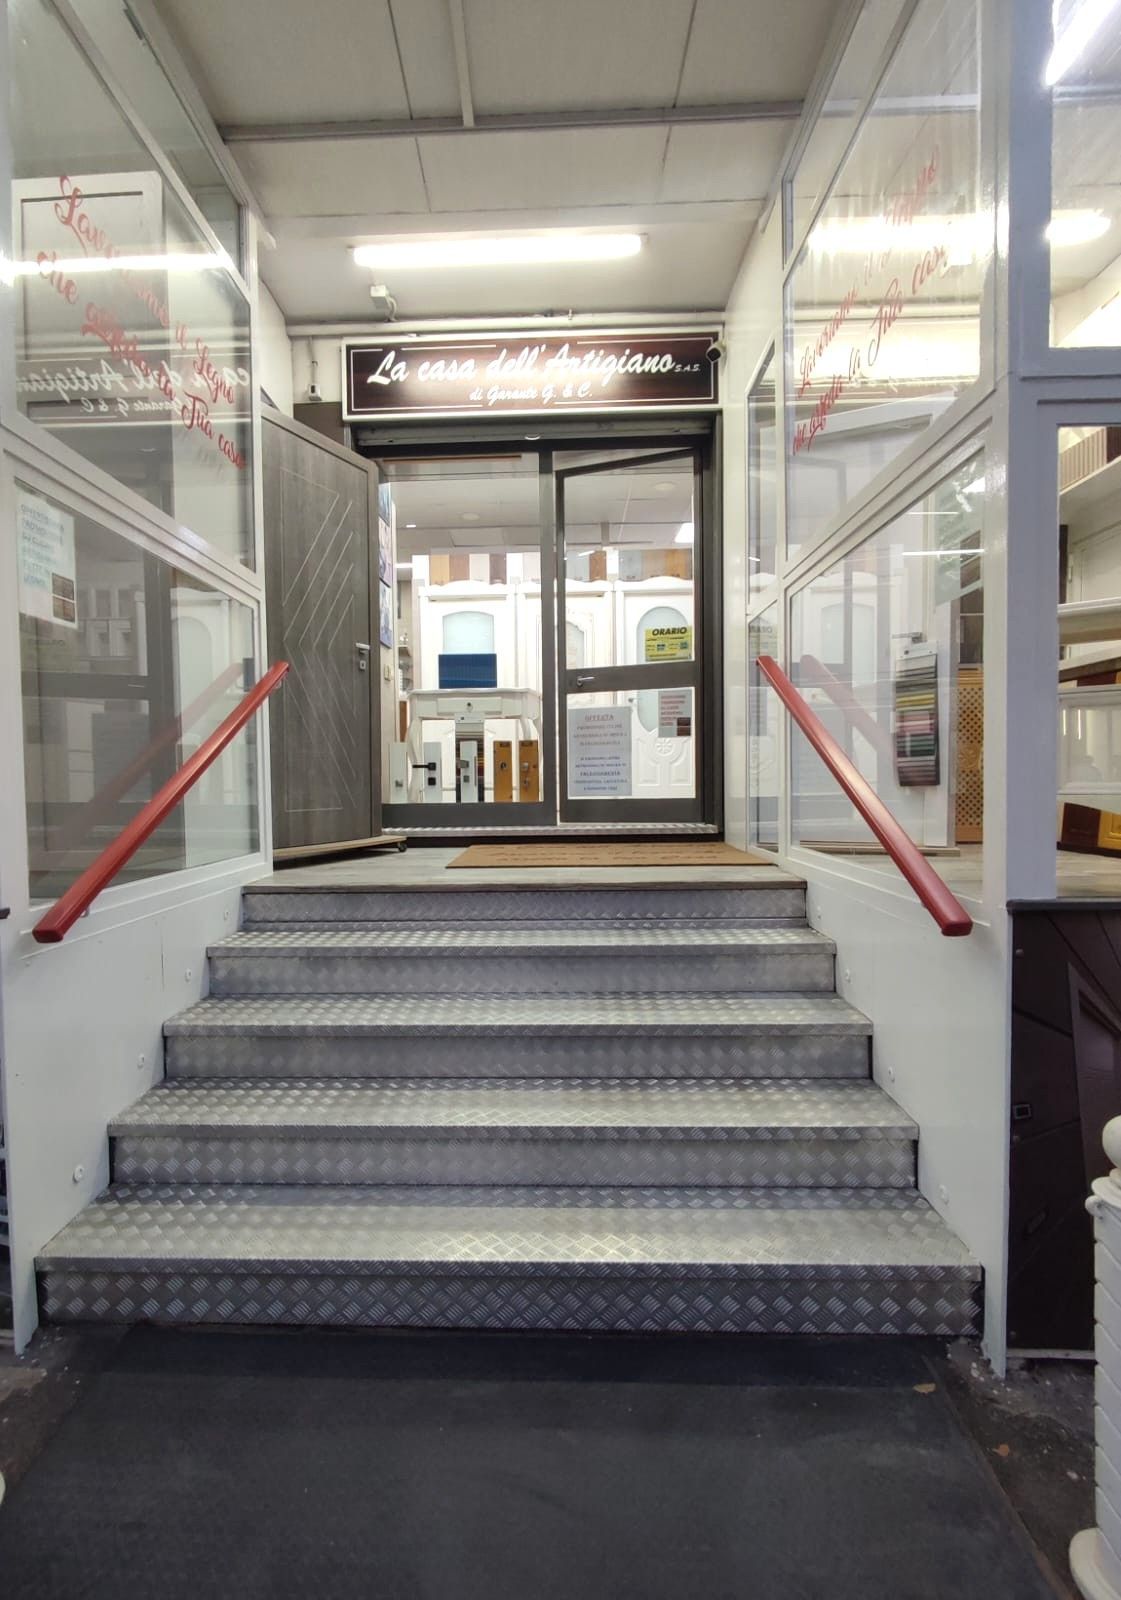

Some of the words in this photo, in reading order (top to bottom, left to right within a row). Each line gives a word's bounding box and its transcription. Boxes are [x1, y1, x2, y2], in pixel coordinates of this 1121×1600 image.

[366, 350, 410, 386] La
[417, 358, 477, 383] casa
[469, 386, 484, 400] di
[652, 627, 688, 636] ORARIO
